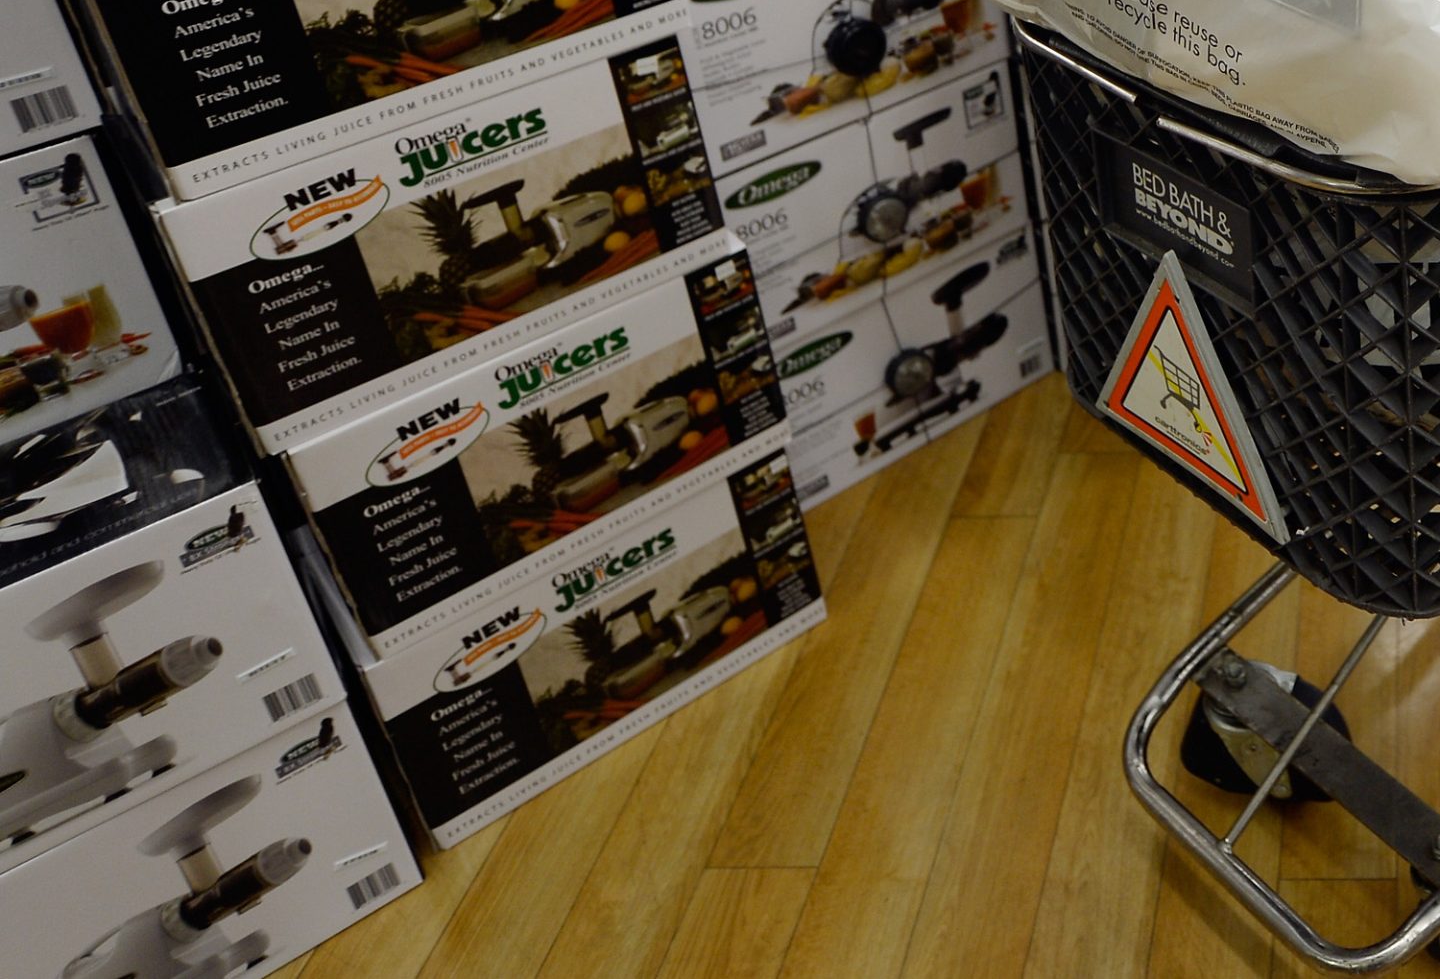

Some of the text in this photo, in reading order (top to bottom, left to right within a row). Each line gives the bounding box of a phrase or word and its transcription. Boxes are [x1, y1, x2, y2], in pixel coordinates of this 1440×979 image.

[174, 7, 255, 39] America's
[701, 6, 757, 41] 8006
[1174, 10, 1219, 48] reuse
[1225, 44, 1243, 63] or
[179, 30, 262, 62] Legendary
[1173, 26, 1201, 57] this
[1207, 45, 1246, 86] bag.
[195, 54, 264, 82] Name In
[193, 8, 688, 183] EXTRACTS LIVING JUICE FROM FRESH FRUITS AND VEGETABLES AND MORE
[195, 73, 282, 107] Fresh Juice
[205, 95, 289, 129] Extraction.
[1272, 115, 1295, 129] AWAY
[1295, 124, 1317, 137] FROM
[395, 121, 467, 155] Omega
[456, 152, 509, 178] Nutrition
[512, 137, 550, 156] Center
[284, 168, 356, 211] NEW
[737, 164, 811, 206] Omega
[1132, 162, 1232, 238] BED BATH &
[736, 208, 788, 241] 8006
[1134, 188, 1234, 256] BEYOND
[259, 279, 332, 315] America's
[264, 298, 339, 334] Legendary
[278, 319, 341, 350] Name In
[274, 406, 344, 442] EXTRACTS
[349, 384, 396, 410] LIVING
[402, 365, 437, 387] JUICE
[443, 348, 478, 369] FROM
[483, 330, 521, 351] FRESH
[526, 309, 567, 332] FRUITS
[572, 297, 596, 312] AND
[277, 335, 356, 373] Fresh Juice
[494, 346, 559, 383] Omega
[287, 355, 363, 392] Extraction.
[396, 397, 461, 441] NEW
[372, 498, 437, 536] America's
[376, 514, 443, 553] Legendary
[388, 533, 444, 567] Name In
[388, 546, 458, 587] Fresh Juice
[451, 587, 493, 614] LIVING
[462, 606, 520, 650] NEW
[452, 738, 489, 764] Name
